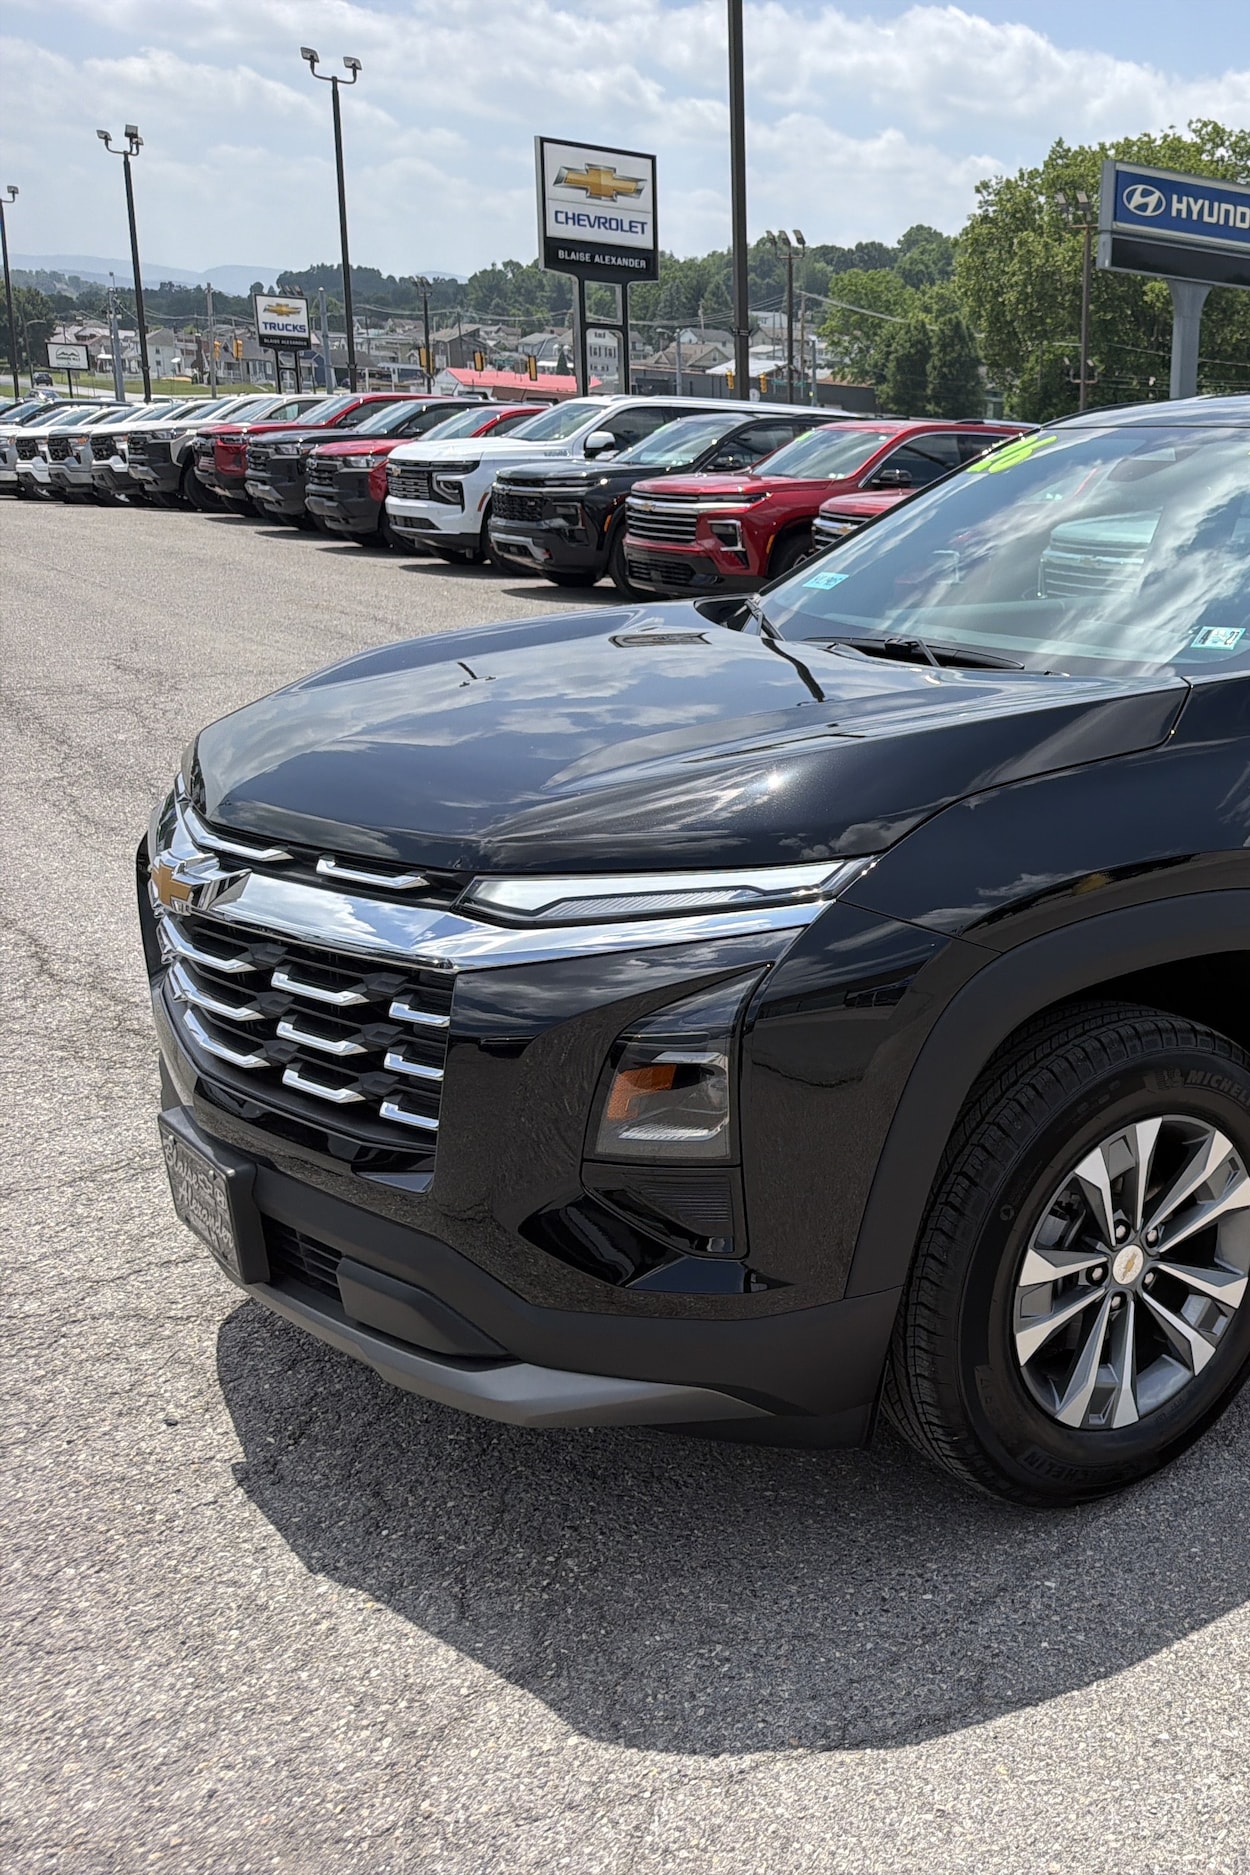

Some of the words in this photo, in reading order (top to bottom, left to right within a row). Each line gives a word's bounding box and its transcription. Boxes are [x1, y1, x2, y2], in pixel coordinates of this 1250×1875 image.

[554, 210, 648, 235] CHEVROLET
[558, 249, 591, 263] BLAISE
[594, 254, 646, 269] ALEXANDER
[262, 321, 306, 333] TRUCKS
